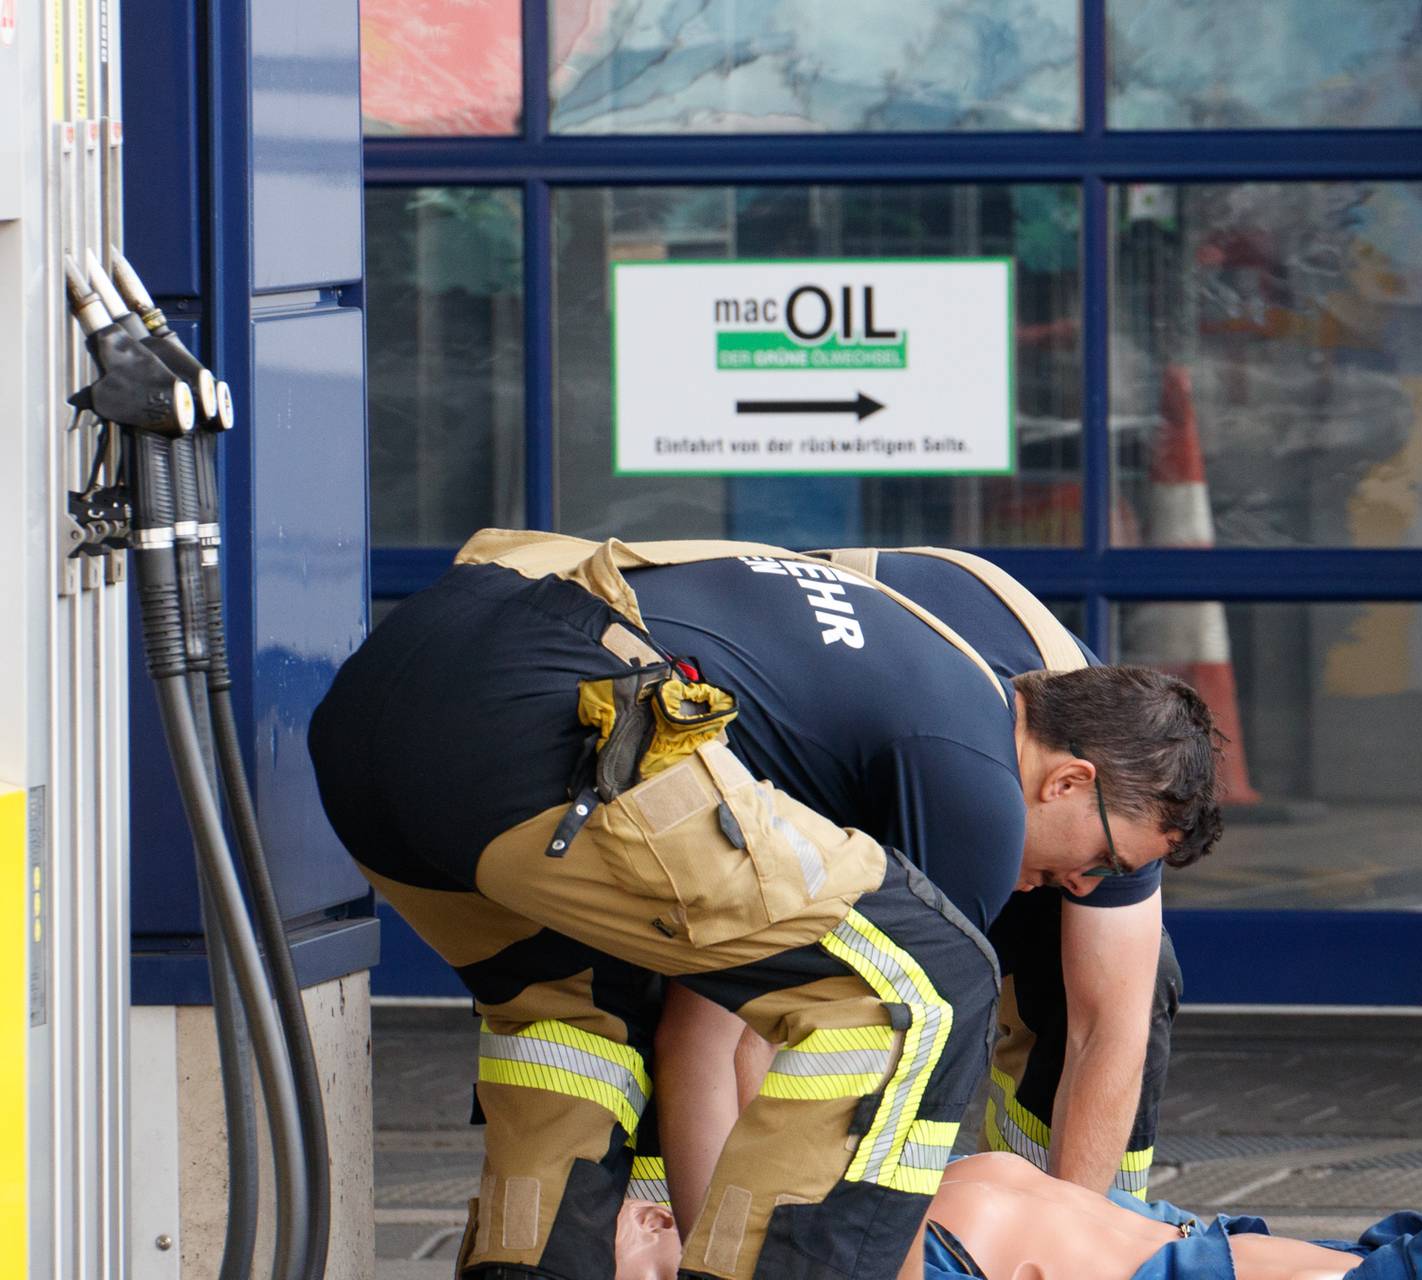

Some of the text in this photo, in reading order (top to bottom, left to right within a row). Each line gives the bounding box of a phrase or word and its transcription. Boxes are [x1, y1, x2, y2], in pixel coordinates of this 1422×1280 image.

[714, 285, 896, 340] mac OIL
[720, 351, 750, 366] DER
[753, 348, 807, 367] GRÜNE
[655, 437, 723, 454] Einfahrt
[730, 441, 760, 454] von
[766, 438, 793, 454] der
[800, 438, 916, 458] rückwärtigen
[779, 560, 877, 649] EHR
